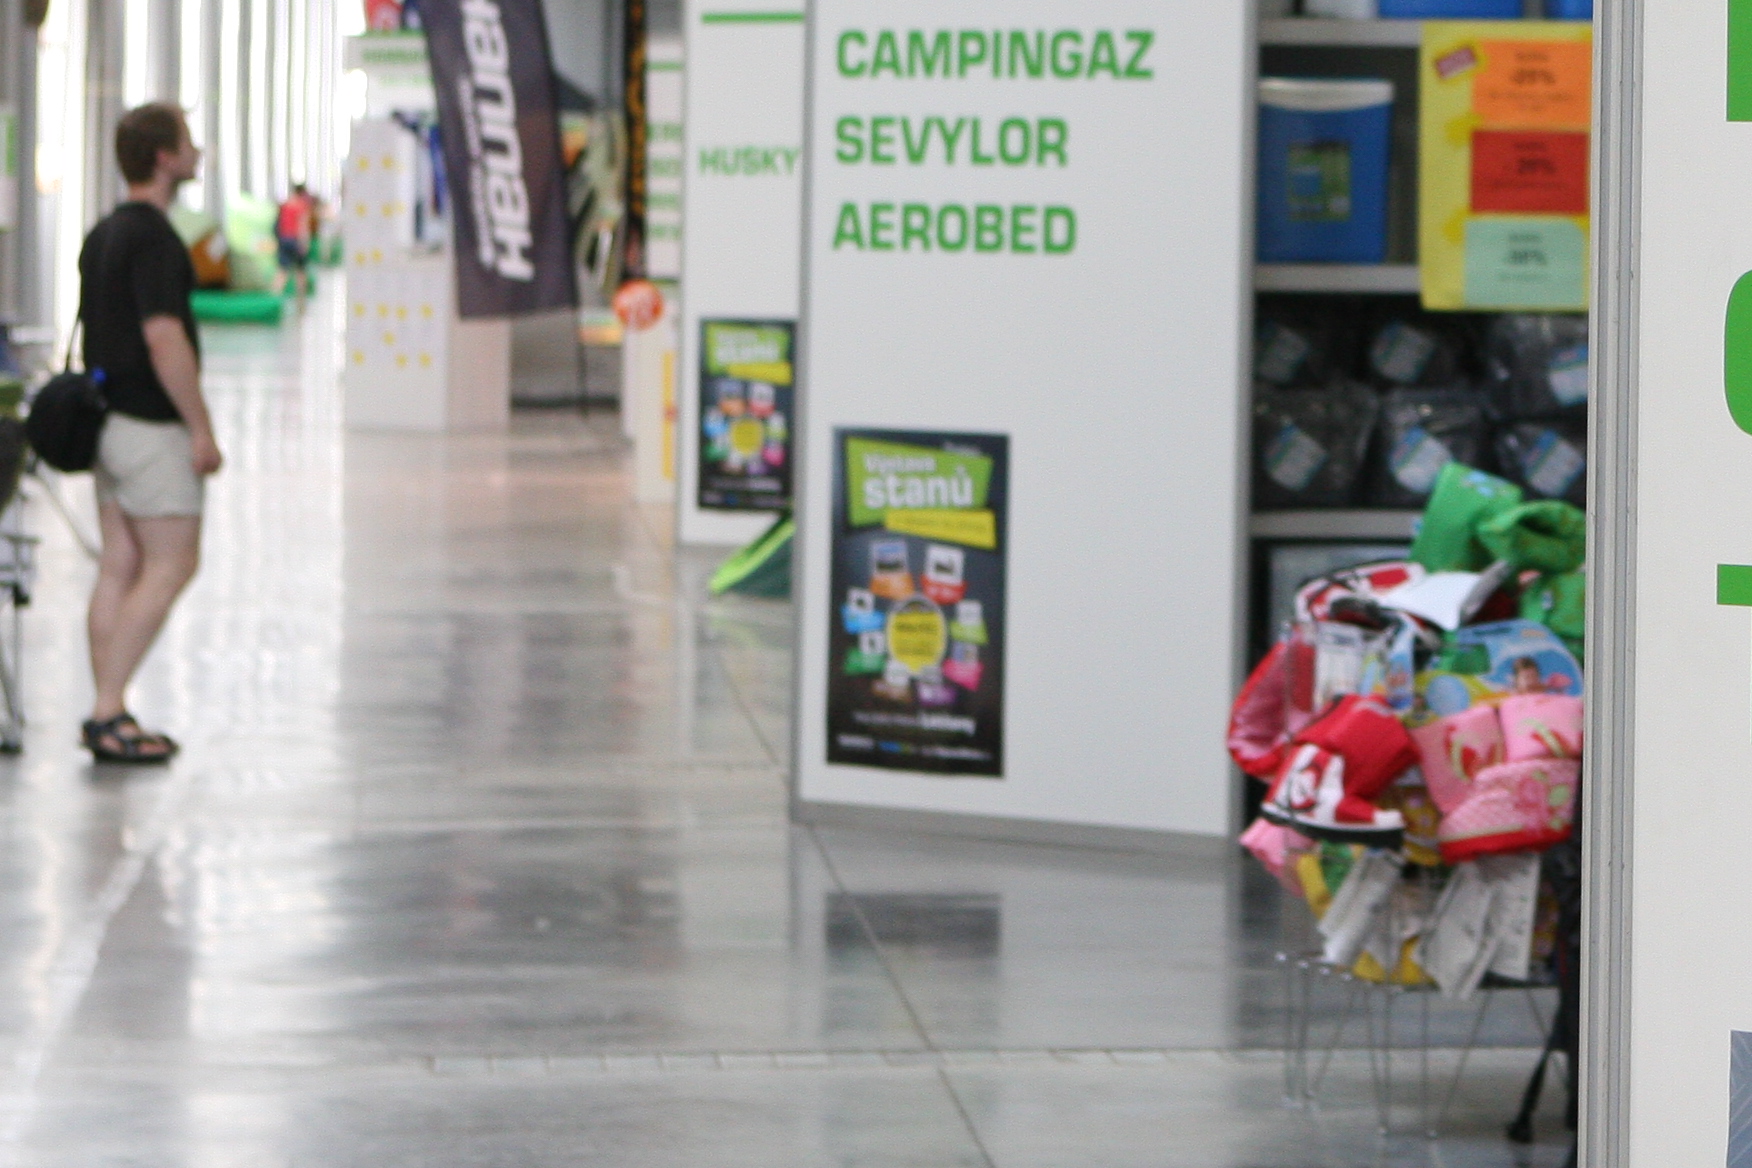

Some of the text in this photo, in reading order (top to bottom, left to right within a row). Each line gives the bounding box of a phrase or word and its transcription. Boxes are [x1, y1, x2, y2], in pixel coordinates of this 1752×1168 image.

[836, 30, 1155, 80] CAMPINGAZ
[699, 146, 799, 176] HUSKY
[835, 116, 1069, 167] SEVYLOR
[832, 202, 1078, 255] AEROBED
[864, 463, 973, 509] stanů
